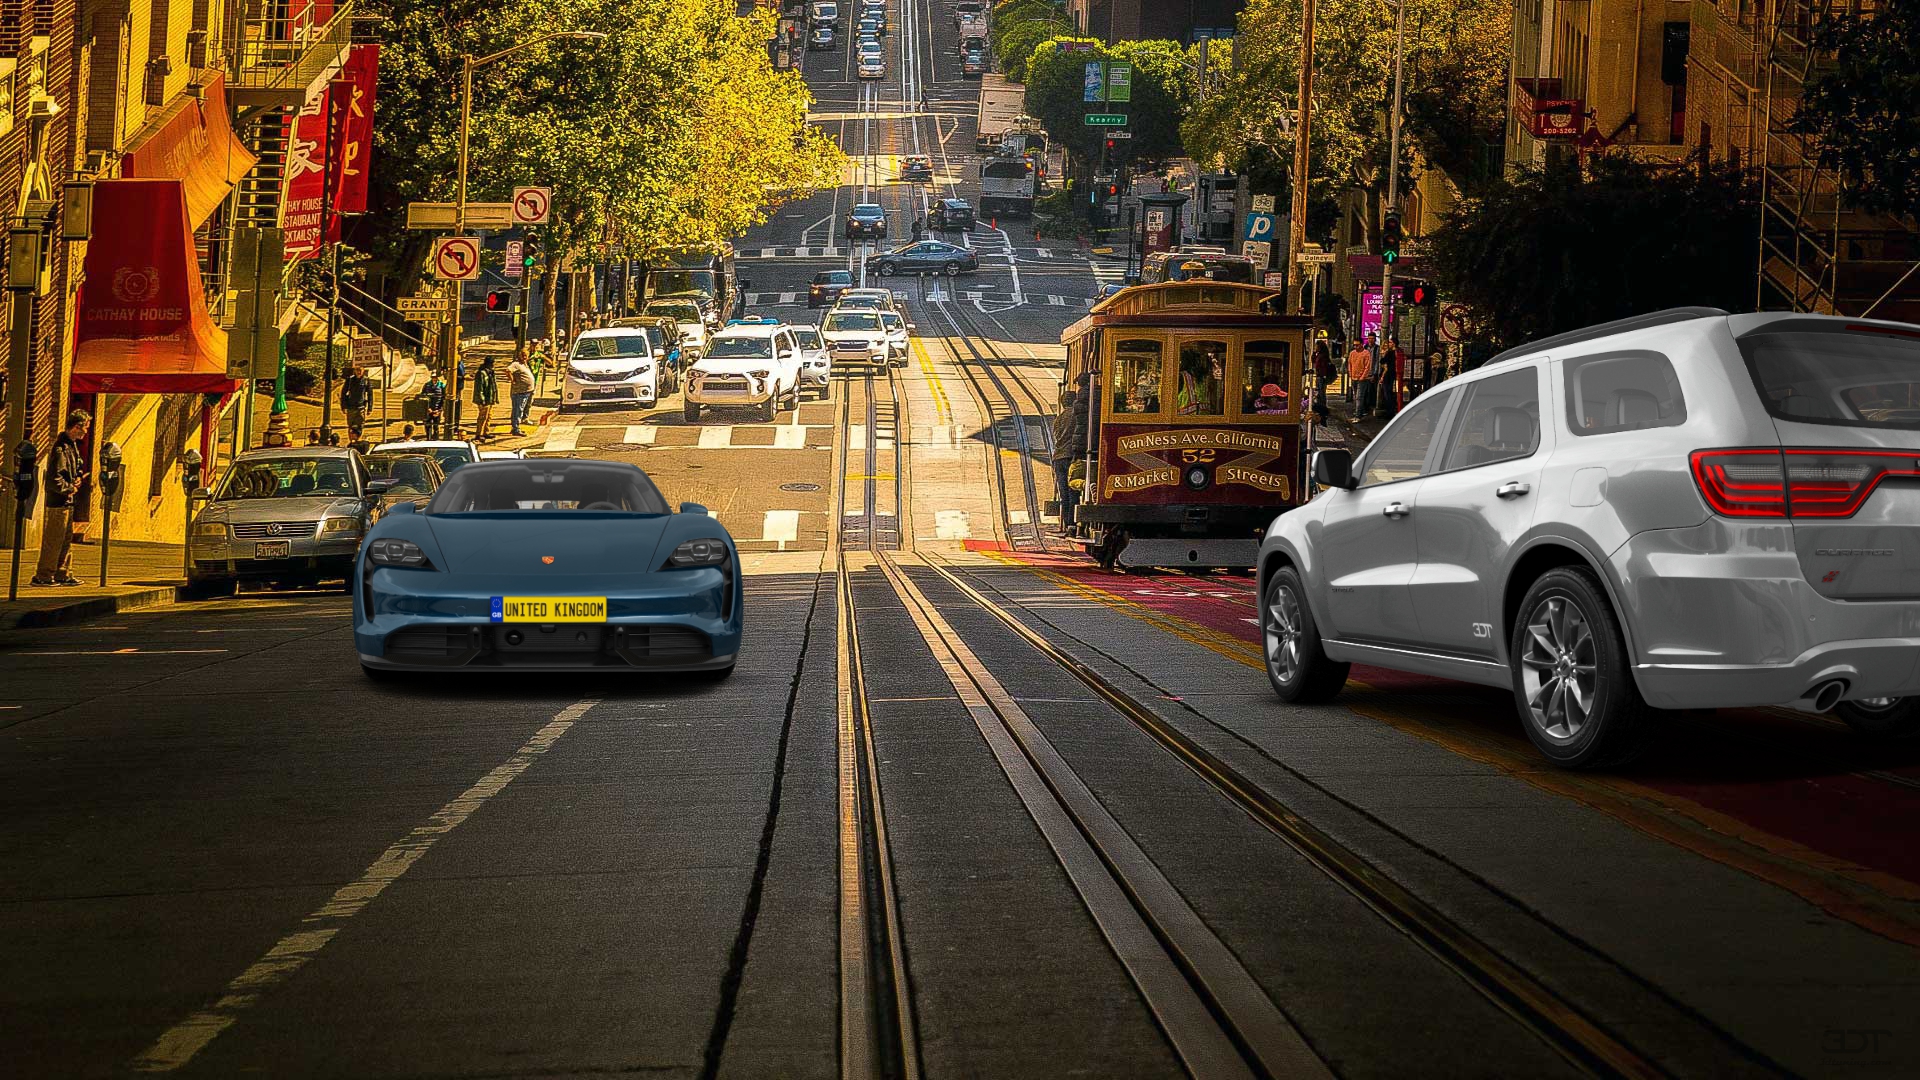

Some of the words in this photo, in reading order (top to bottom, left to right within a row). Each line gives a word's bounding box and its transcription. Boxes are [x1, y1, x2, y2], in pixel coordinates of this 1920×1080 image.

[285, 200, 301, 213] THAY
[302, 198, 323, 211] HOUSE
[284, 213, 321, 228] STAURANT
[284, 228, 313, 243] CKTAILS
[401, 300, 446, 309] GRANT
[87, 308, 137, 321] CATHAY
[139, 308, 182, 321] HOUSE
[1121, 438, 1144, 450] Van
[1145, 433, 1177, 447] Ness
[1215, 432, 1280, 450] California
[1182, 448, 1216, 463] 52
[1113, 475, 1124, 488] &
[1125, 469, 1174, 488] Market
[1227, 468, 1282, 487] Streets
[505, 602, 547, 617] UNITED
[554, 602, 604, 617] KINGDOM
